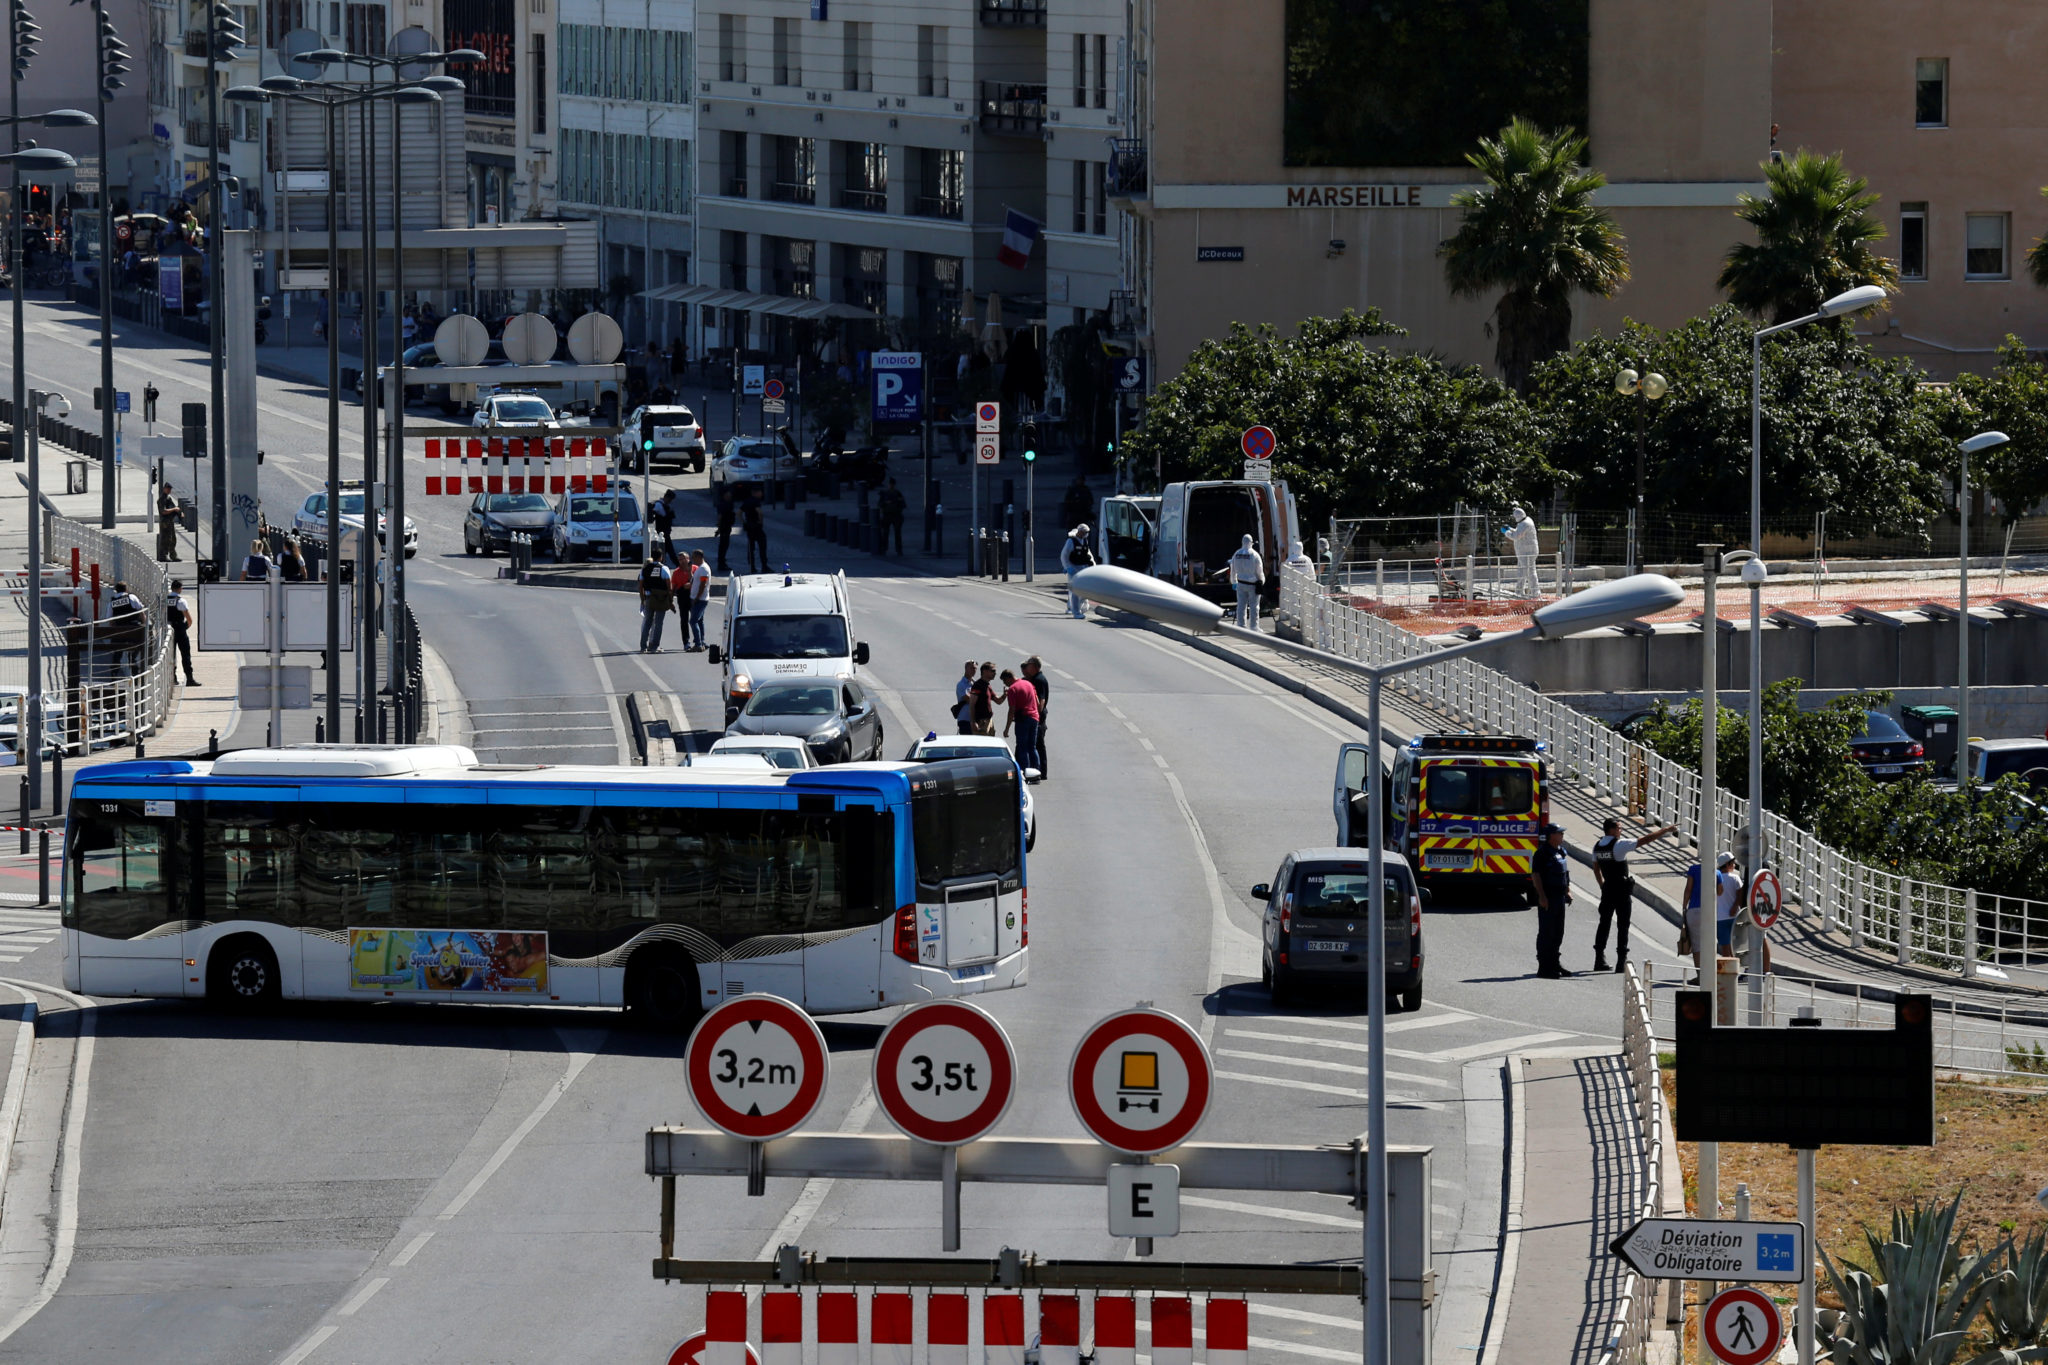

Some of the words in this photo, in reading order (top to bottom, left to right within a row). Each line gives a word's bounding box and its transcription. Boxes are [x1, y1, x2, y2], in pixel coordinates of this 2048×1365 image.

[1287, 187, 1421, 206] MARSEILLE
[1199, 250, 1242, 259] JCDecaux
[878, 356, 916, 365] INDIGO
[877, 372, 904, 407] P
[112, 598, 129, 607] POLICE
[923, 779, 938, 790] 1331
[100, 804, 118, 813] 1331
[1425, 823, 1437, 831] 17
[1481, 824, 1524, 833] POLICE
[1003, 879, 1018, 889] RTM
[410, 951, 441, 968] Speed
[459, 952, 491, 968] Water
[715, 1048, 796, 1087] 3,2m
[910, 1055, 978, 1097] 3,5t
[1131, 1182, 1154, 1218] E
[1661, 1229, 1743, 1248] Déviation
[1761, 1246, 1791, 1260] 3,2m
[1654, 1252, 1743, 1274] Obligatoire
